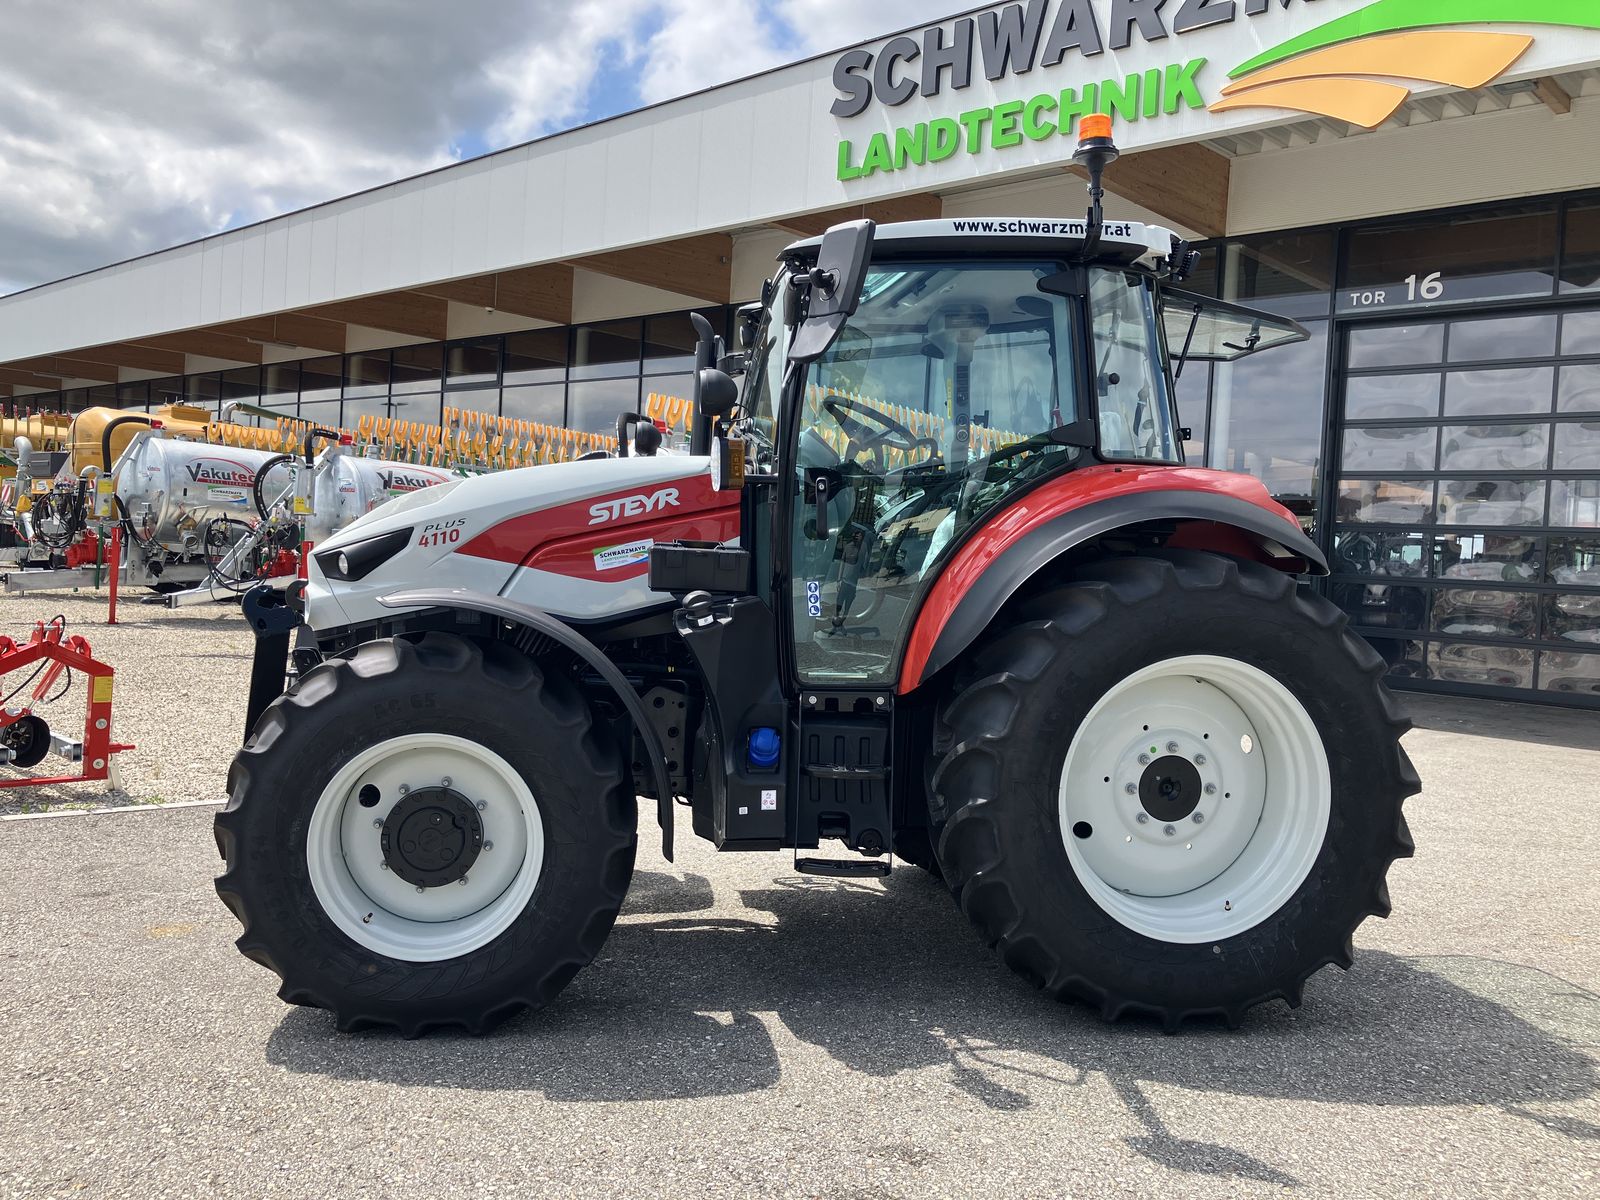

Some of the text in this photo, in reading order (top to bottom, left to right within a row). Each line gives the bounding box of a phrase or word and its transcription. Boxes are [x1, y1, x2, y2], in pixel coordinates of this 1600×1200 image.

[830, 0, 1319, 118] SCHWAR
[837, 57, 1208, 181] LANDTECHNIK
[953, 219, 1131, 237] www.schwarzmr.at
[1350, 271, 1444, 306] TOR 16
[185, 462, 256, 483] Vakutec
[376, 470, 441, 490] Vakut
[588, 487, 680, 526] STEYR
[423, 517, 466, 533] PLUS
[418, 528, 460, 548] 4110
[599, 545, 646, 559] SCHWARZMAYR
